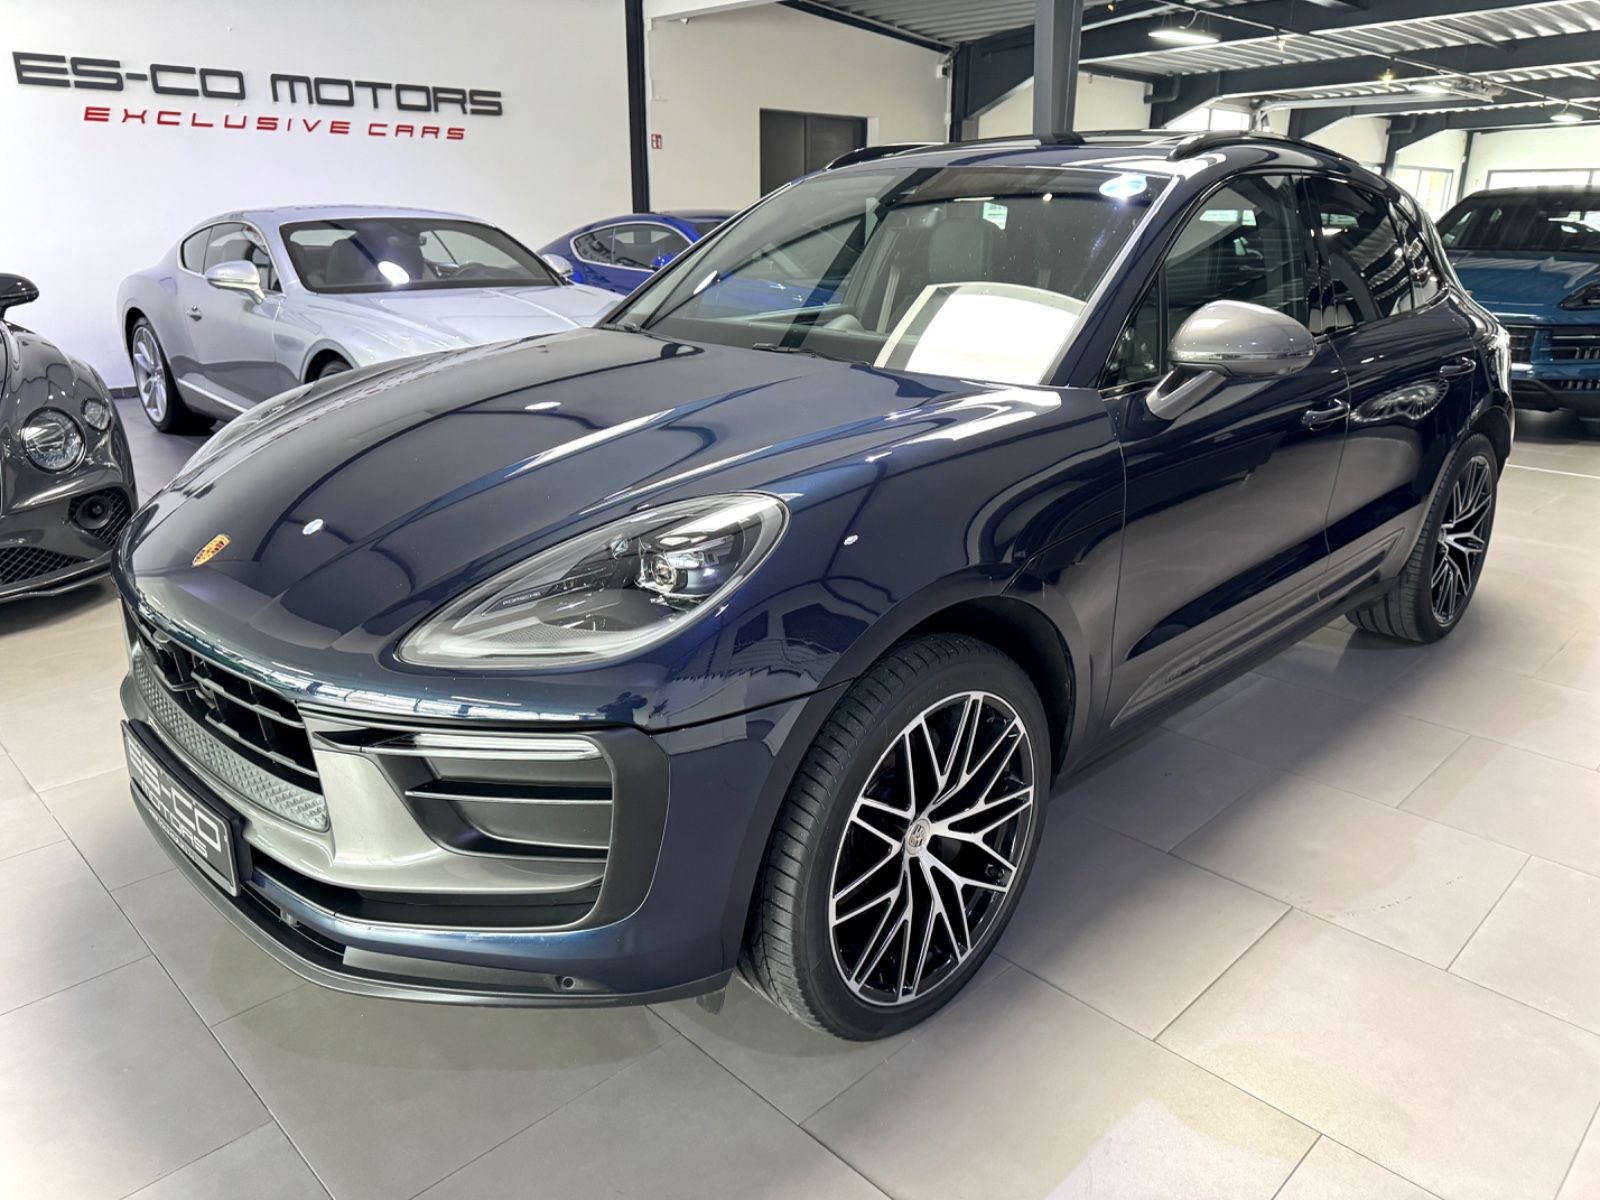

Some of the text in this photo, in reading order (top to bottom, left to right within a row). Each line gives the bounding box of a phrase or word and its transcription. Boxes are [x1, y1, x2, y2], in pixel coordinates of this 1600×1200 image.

[12, 52, 503, 117] ES-CO MOTORS
[83, 105, 465, 140] EXCLUSIVE CARS
[127, 736, 222, 852] ES-CO
[140, 779, 208, 858] MOTORS
